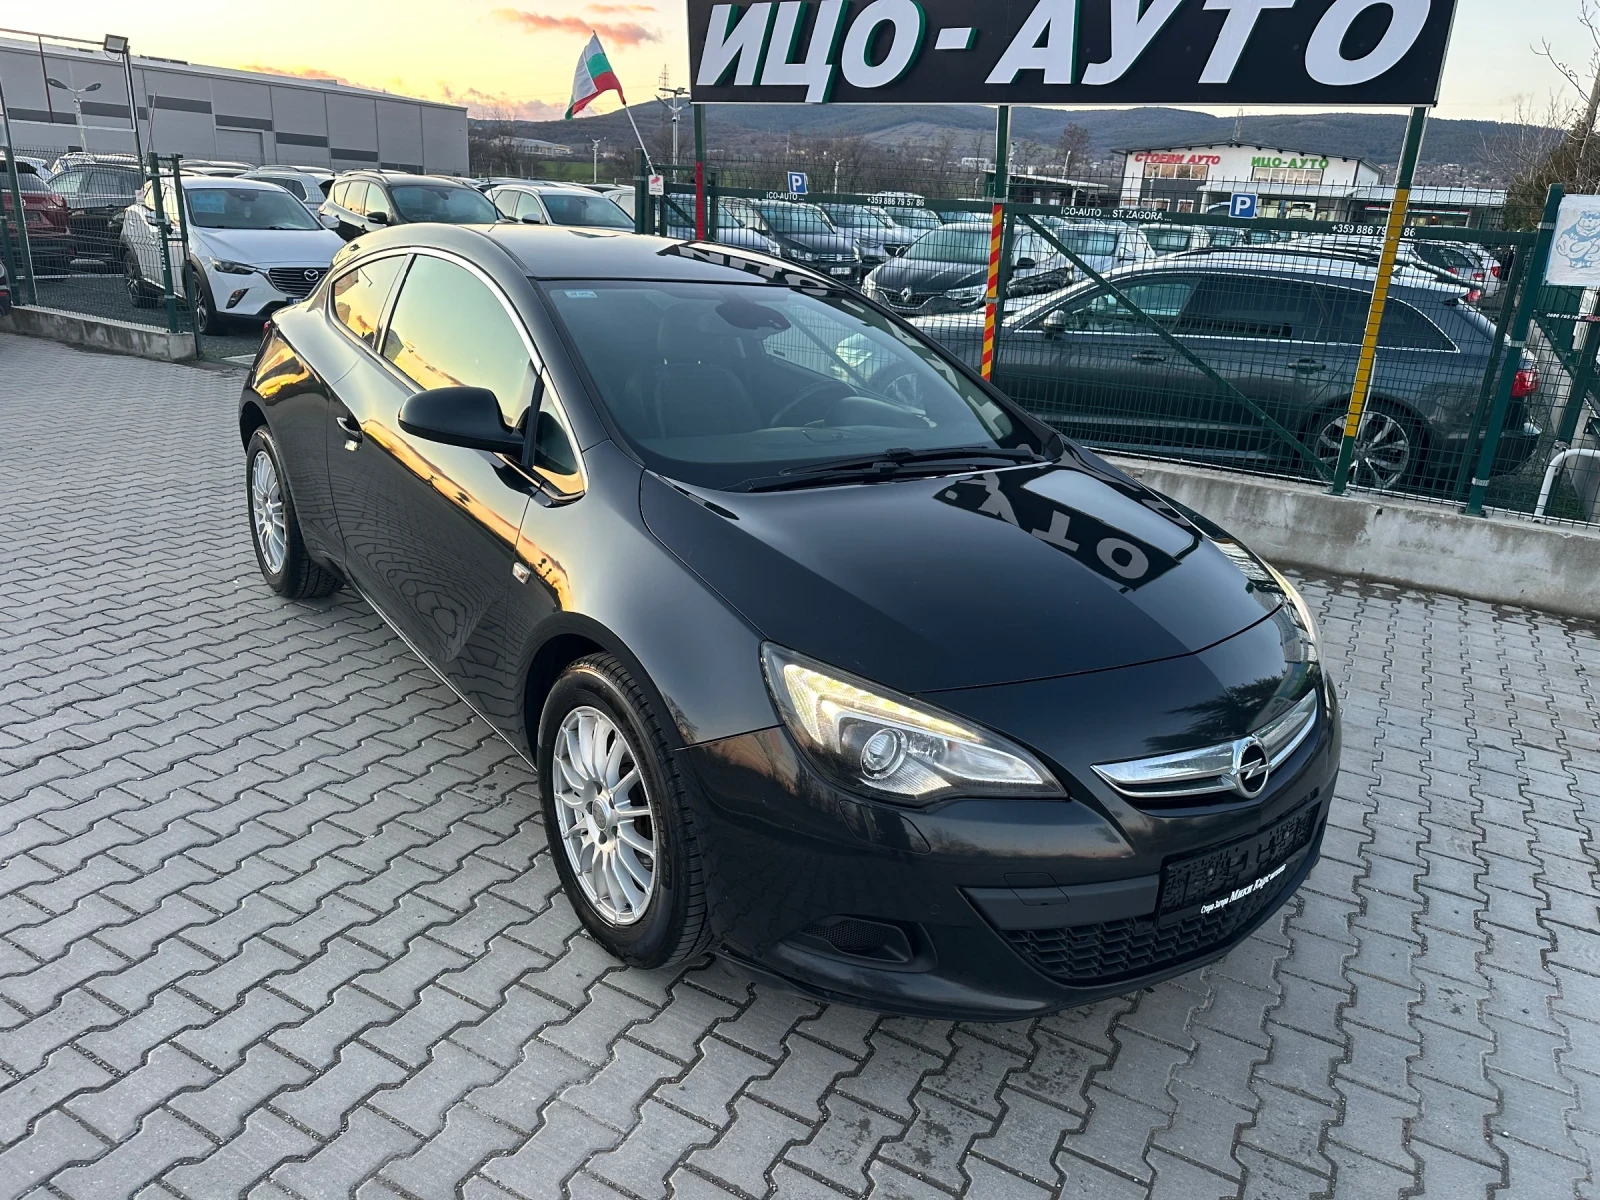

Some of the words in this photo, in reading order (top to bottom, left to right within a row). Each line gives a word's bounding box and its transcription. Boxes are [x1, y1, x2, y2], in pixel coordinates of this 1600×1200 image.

[1134, 153, 1185, 164] СТОЕВИ
[1187, 154, 1221, 165] АУТО
[1251, 156, 1329, 169] ИЦО-АУТО
[791, 175, 802, 192] P
[866, 196, 882, 205] +359
[883, 197, 896, 206] 886
[1234, 196, 1251, 215] P
[1112, 209, 1124, 218] ST.
[1126, 209, 1163, 221] ZAGORA
[1331, 223, 1354, 234] +359
[1356, 225, 1374, 235] 886
[1403, 227, 1416, 237] 86
